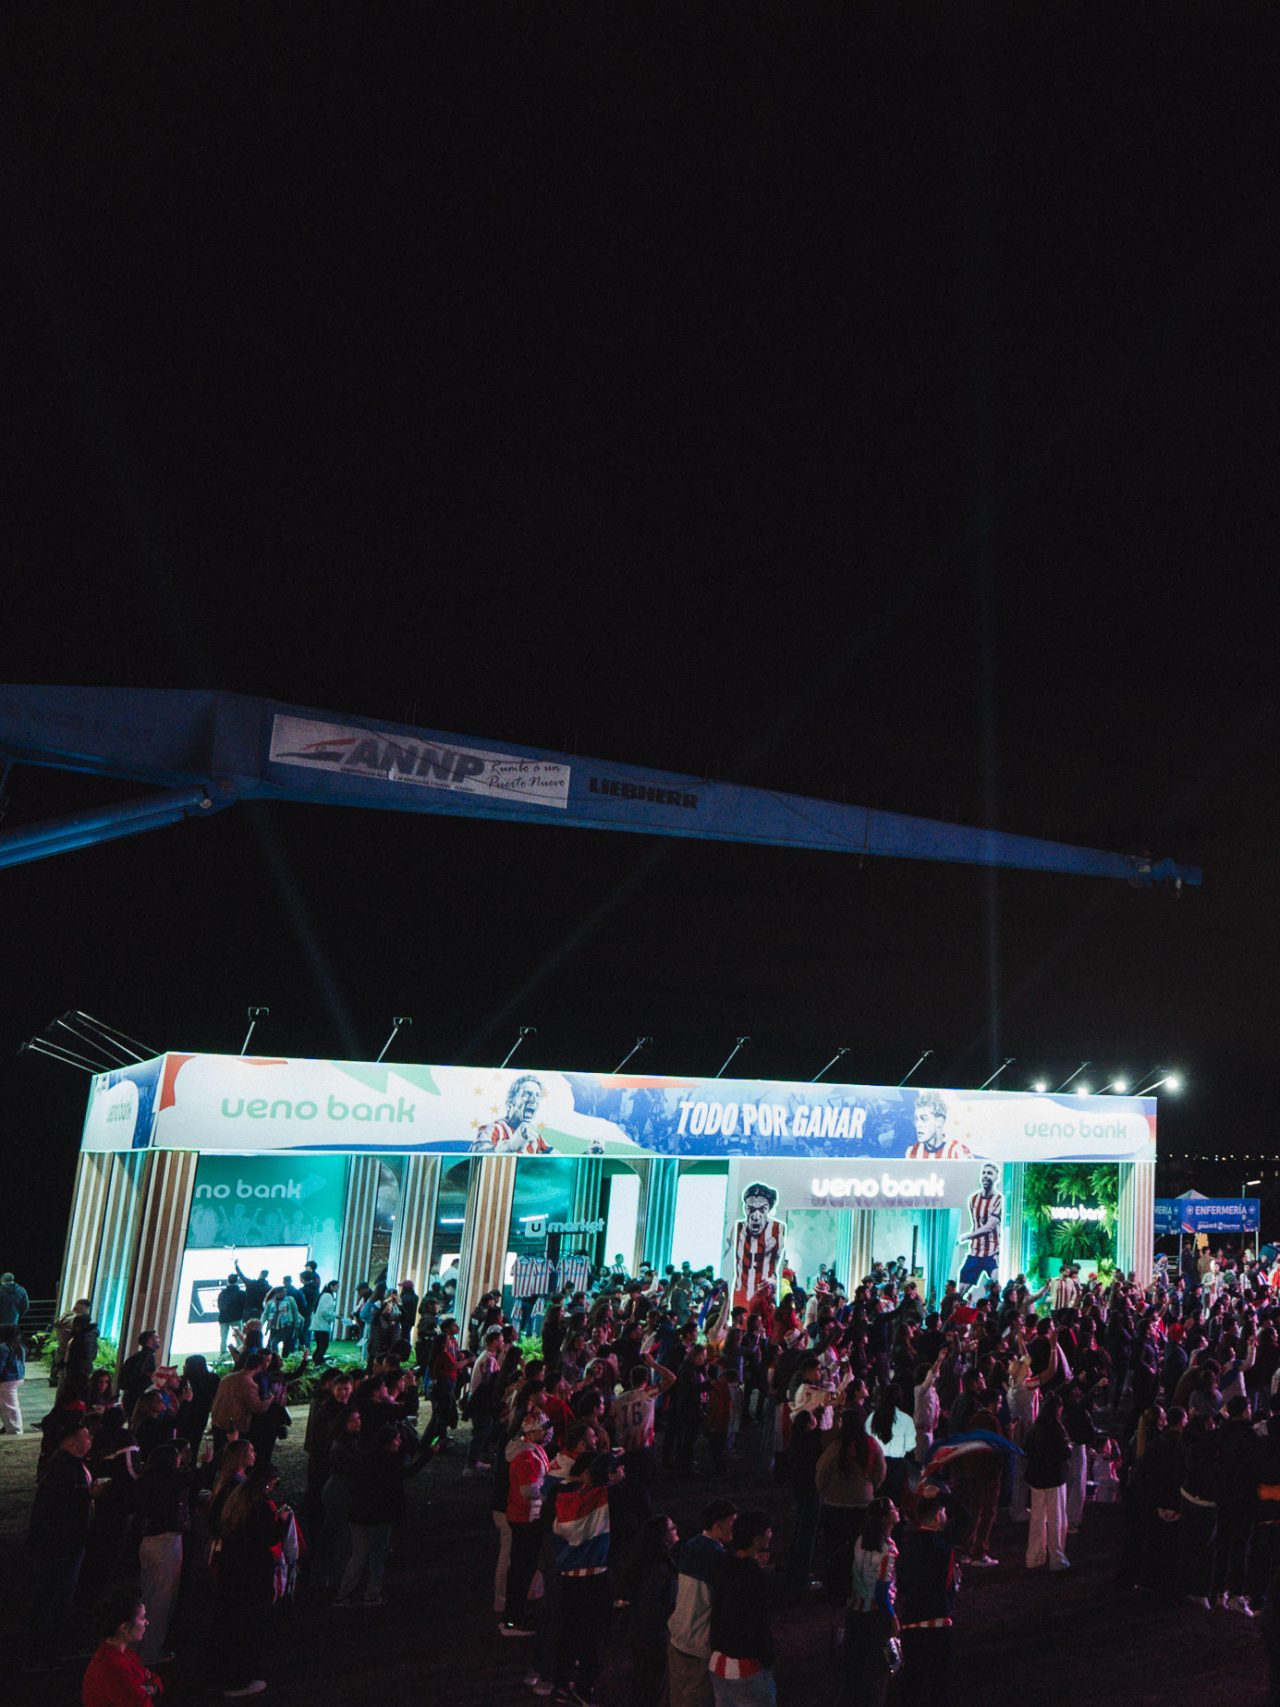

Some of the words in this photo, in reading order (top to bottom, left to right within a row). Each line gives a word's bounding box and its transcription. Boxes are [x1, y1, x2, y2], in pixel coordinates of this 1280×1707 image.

[345, 738, 484, 783] ANNP
[589, 777, 698, 809] LIEBHERR
[221, 1099, 319, 1121] ueno
[327, 1094, 416, 1123] bank
[677, 1101, 737, 1135] TODO
[742, 1104, 789, 1136] POR
[792, 1105, 866, 1138] GANAR
[1024, 1120, 1076, 1138] ueno
[1079, 1118, 1127, 1139] bank
[237, 1179, 302, 1200] bank
[811, 1178, 879, 1198] ueno
[881, 1173, 945, 1198] bank
[1195, 1203, 1247, 1215] ENFERMERÍA
[548, 1218, 605, 1234] market
